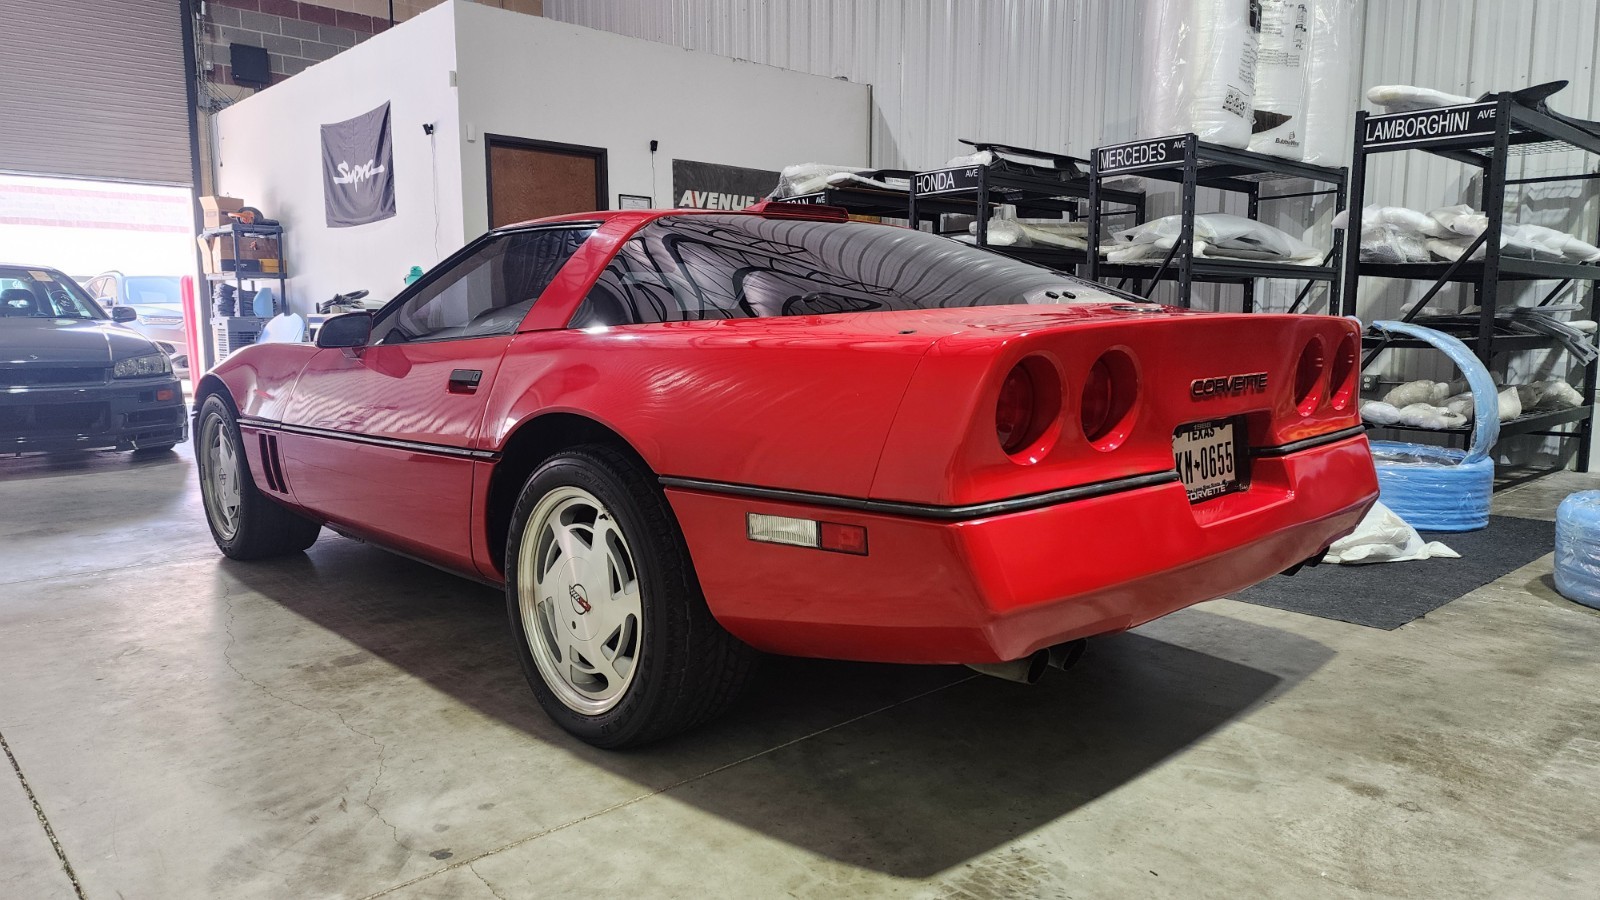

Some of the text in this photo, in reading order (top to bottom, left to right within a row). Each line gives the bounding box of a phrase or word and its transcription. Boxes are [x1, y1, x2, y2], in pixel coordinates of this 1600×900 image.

[1366, 109, 1497, 142] LAMBORGHINI AVE
[1100, 140, 1186, 169] MERCEDES AVE
[333, 159, 385, 192] Supra
[916, 169, 979, 193] HONDA AVE
[679, 189, 755, 211] AVENUE
[1190, 371, 1268, 397] CORVETTE
[1187, 428, 1215, 442] TEXAS
